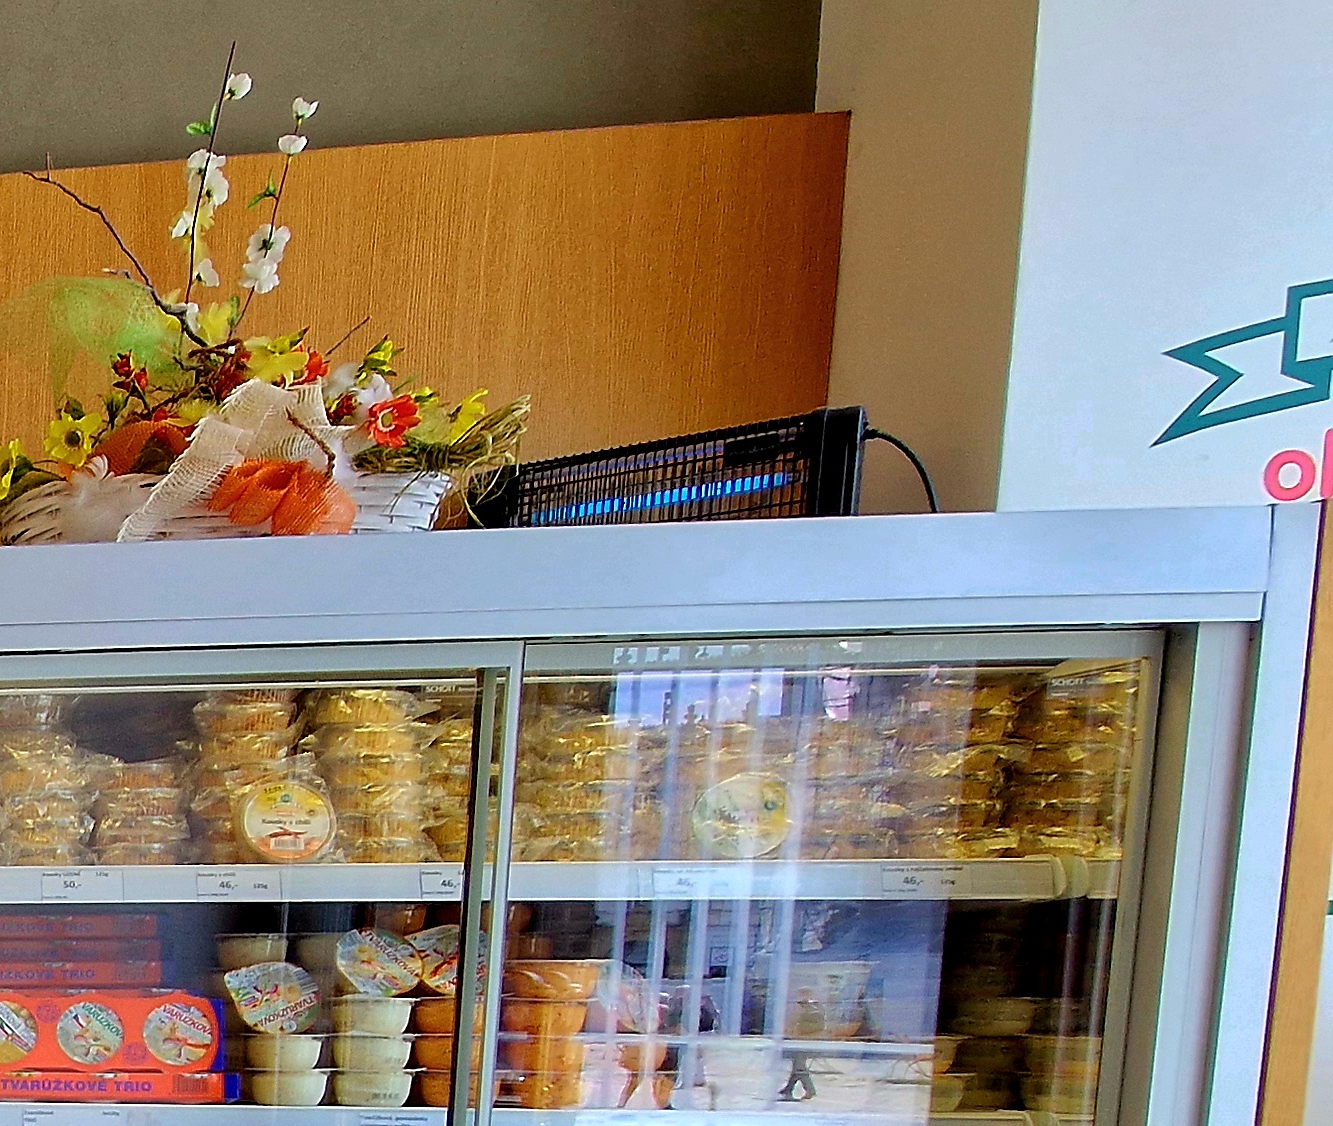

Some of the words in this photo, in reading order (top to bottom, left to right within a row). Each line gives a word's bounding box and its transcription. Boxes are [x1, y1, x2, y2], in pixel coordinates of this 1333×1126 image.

[63, 880, 82, 889] 50,-
[219, 881, 238, 890] 46,-
[441, 879, 460, 889] 46,-
[903, 876, 923, 886] 46,-
[113, 1079, 153, 1092] TRIO
